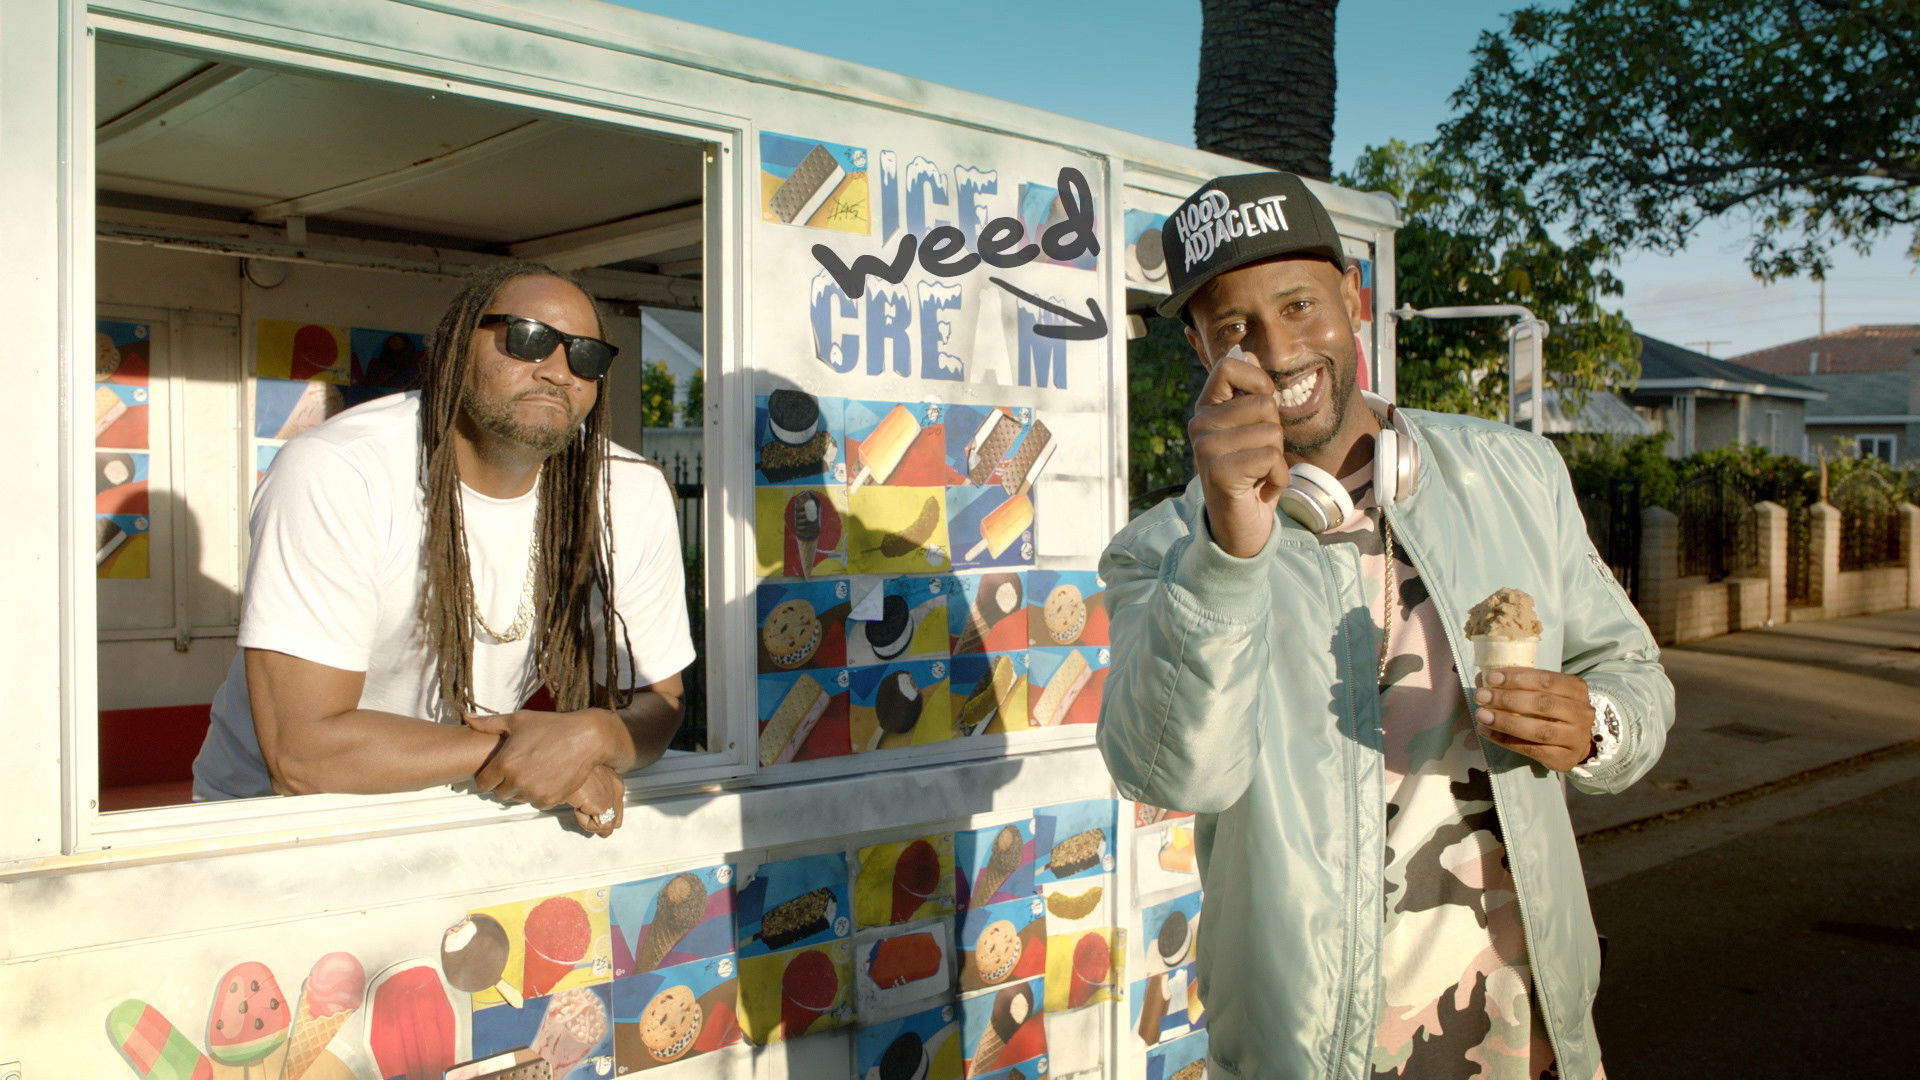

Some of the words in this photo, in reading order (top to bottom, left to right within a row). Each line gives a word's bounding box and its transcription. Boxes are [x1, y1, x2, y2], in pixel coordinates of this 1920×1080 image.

[879, 149, 998, 250] ICE
[1175, 189, 1230, 243] HOOD
[1185, 195, 1289, 273] ADJACENT
[810, 268, 1068, 390] CREAM
